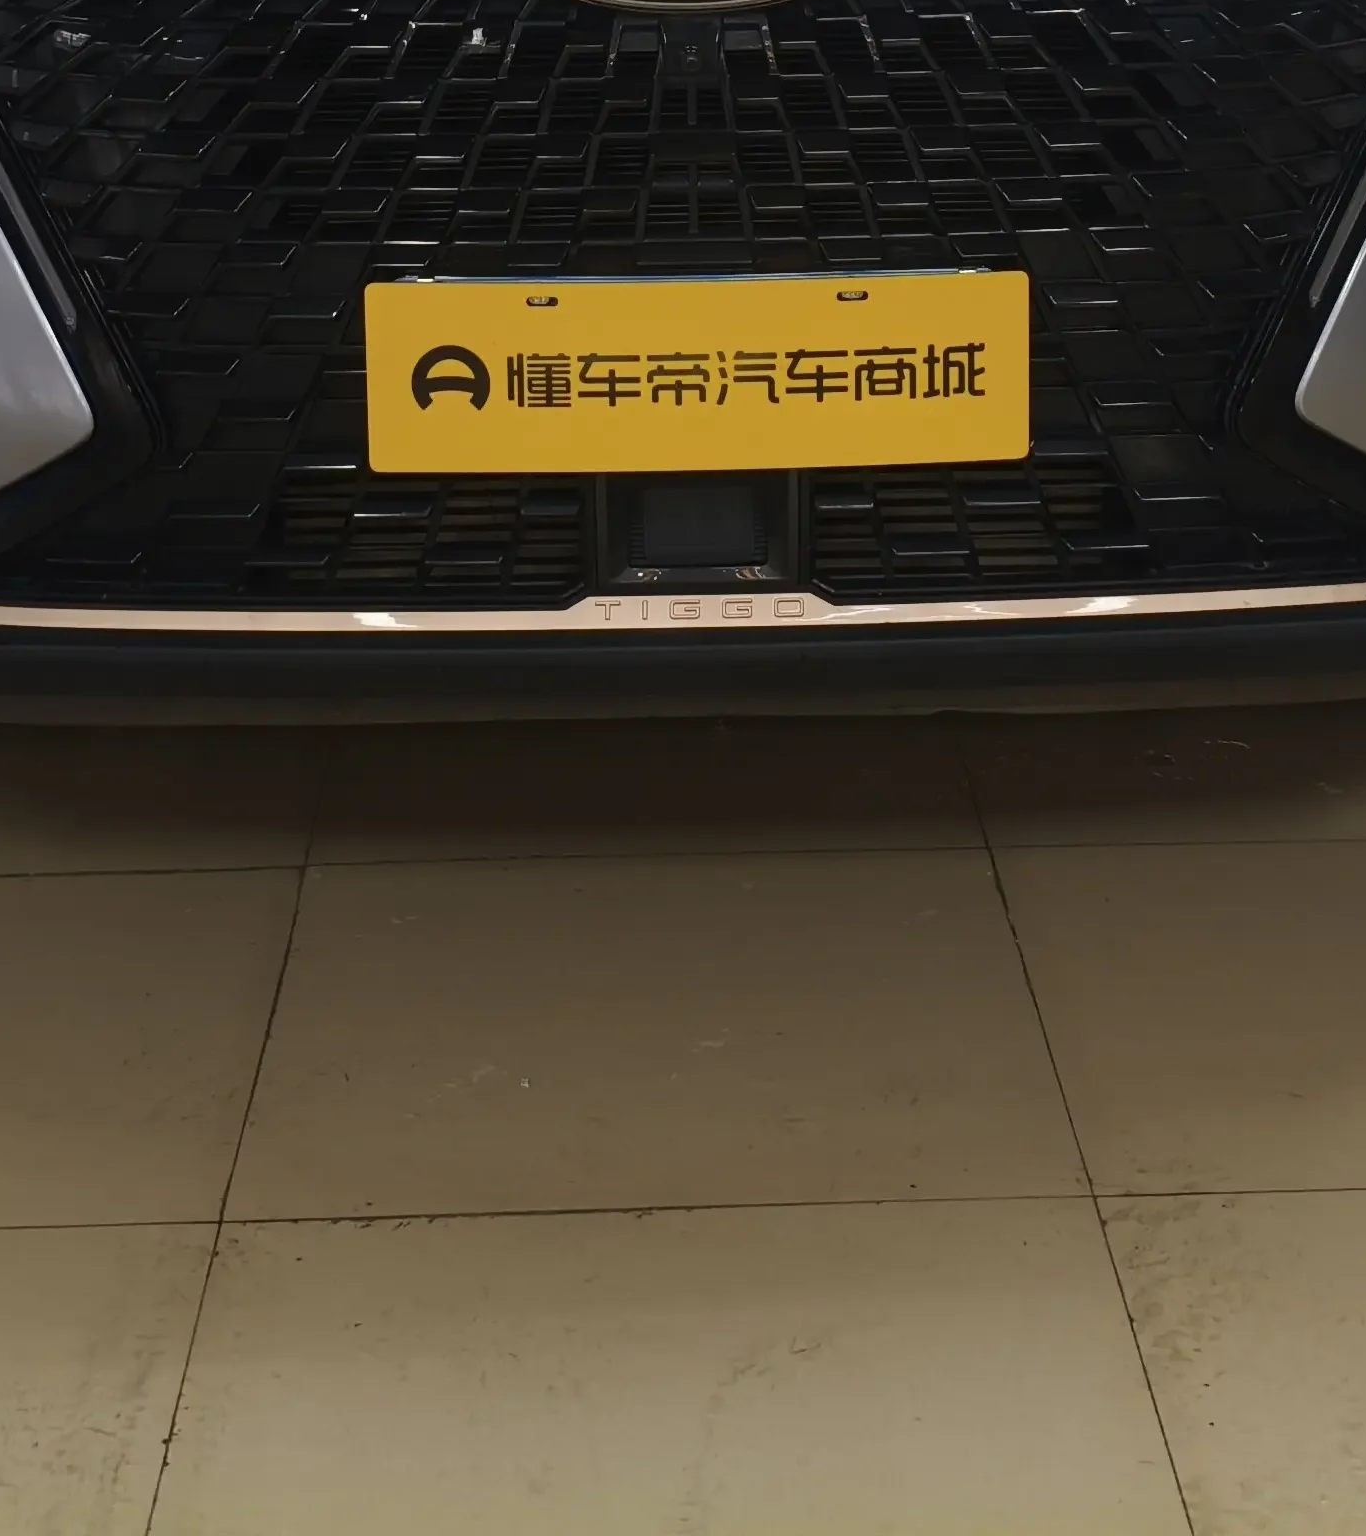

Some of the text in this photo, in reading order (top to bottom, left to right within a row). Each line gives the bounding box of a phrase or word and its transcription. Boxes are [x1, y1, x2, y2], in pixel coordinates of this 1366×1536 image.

[506, 342, 987, 409] 懂车帝汽车商城
[594, 596, 806, 621] TIGGO
